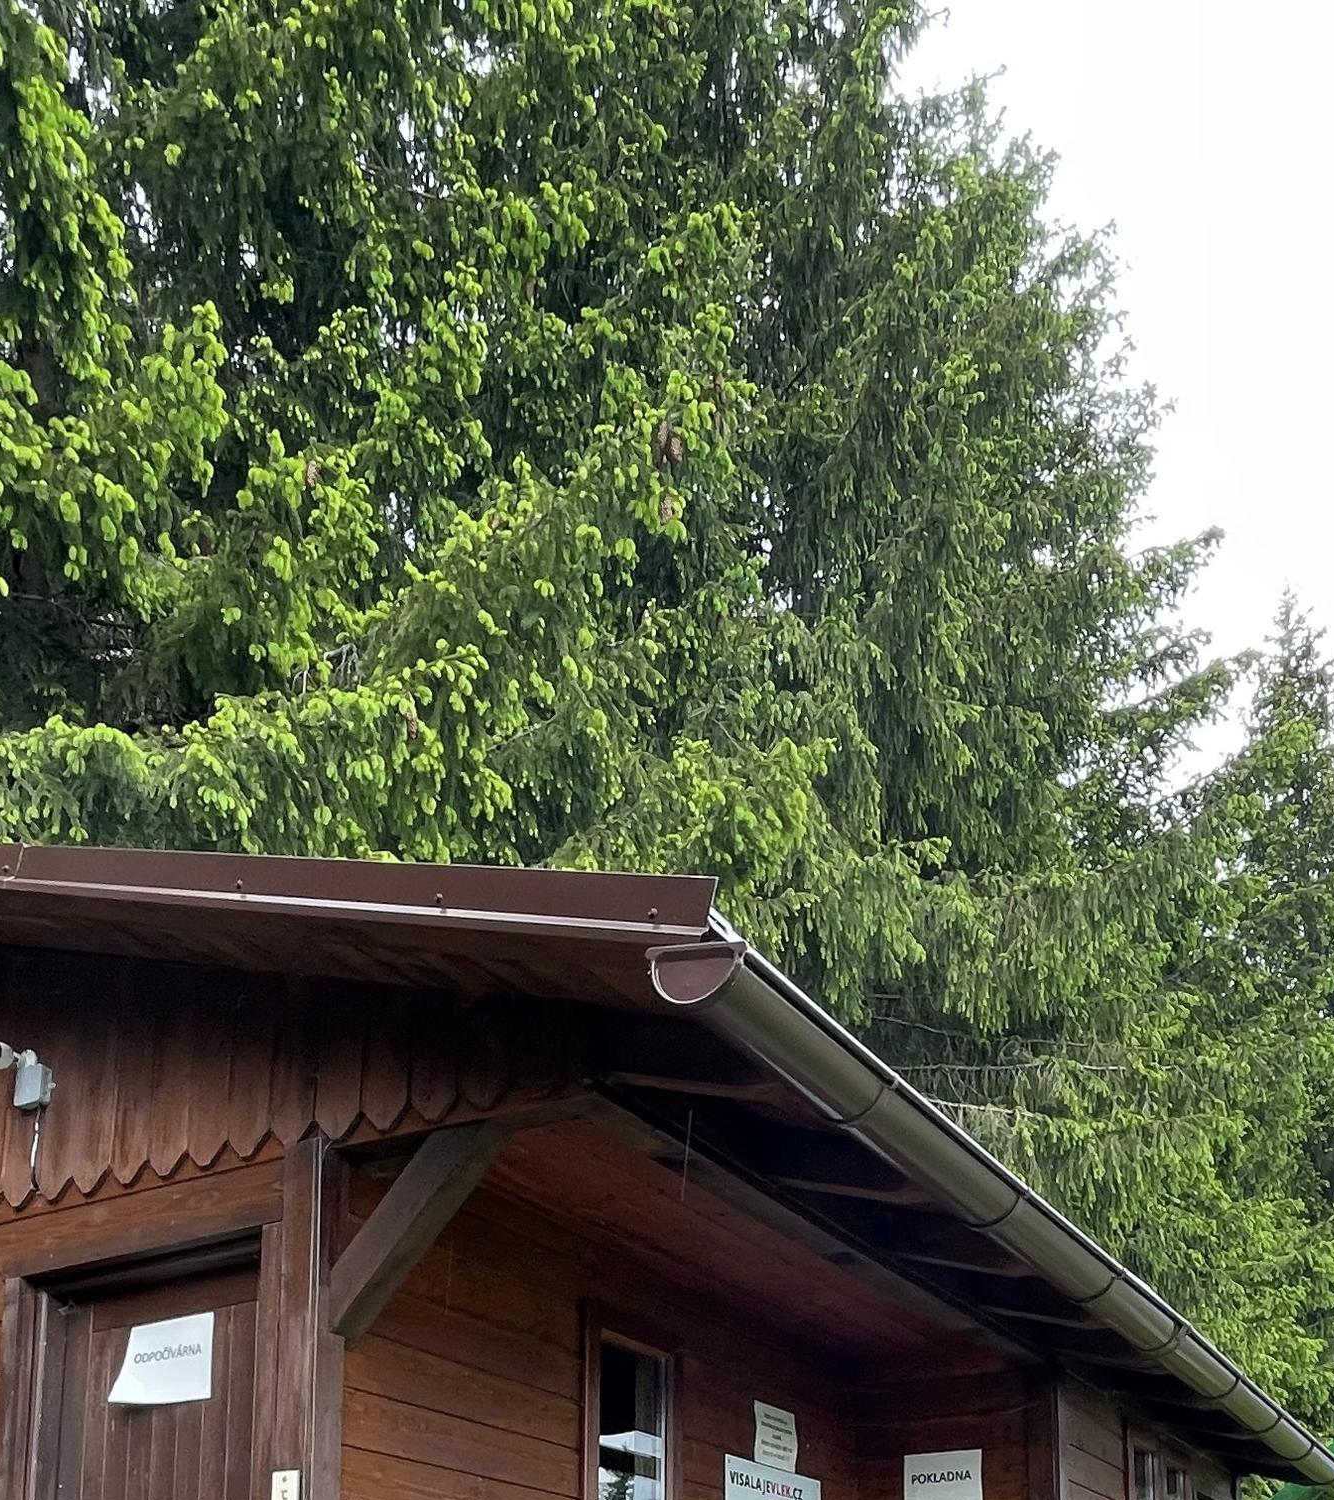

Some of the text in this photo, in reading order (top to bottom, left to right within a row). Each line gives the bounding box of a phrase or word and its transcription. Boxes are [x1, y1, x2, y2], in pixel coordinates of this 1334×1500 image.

[134, 1343, 202, 1364] ODPOČÍVÁRNA
[729, 1470, 803, 1500] VISALAJEVLEK.CZ
[911, 1469, 972, 1485] POKLADNA
